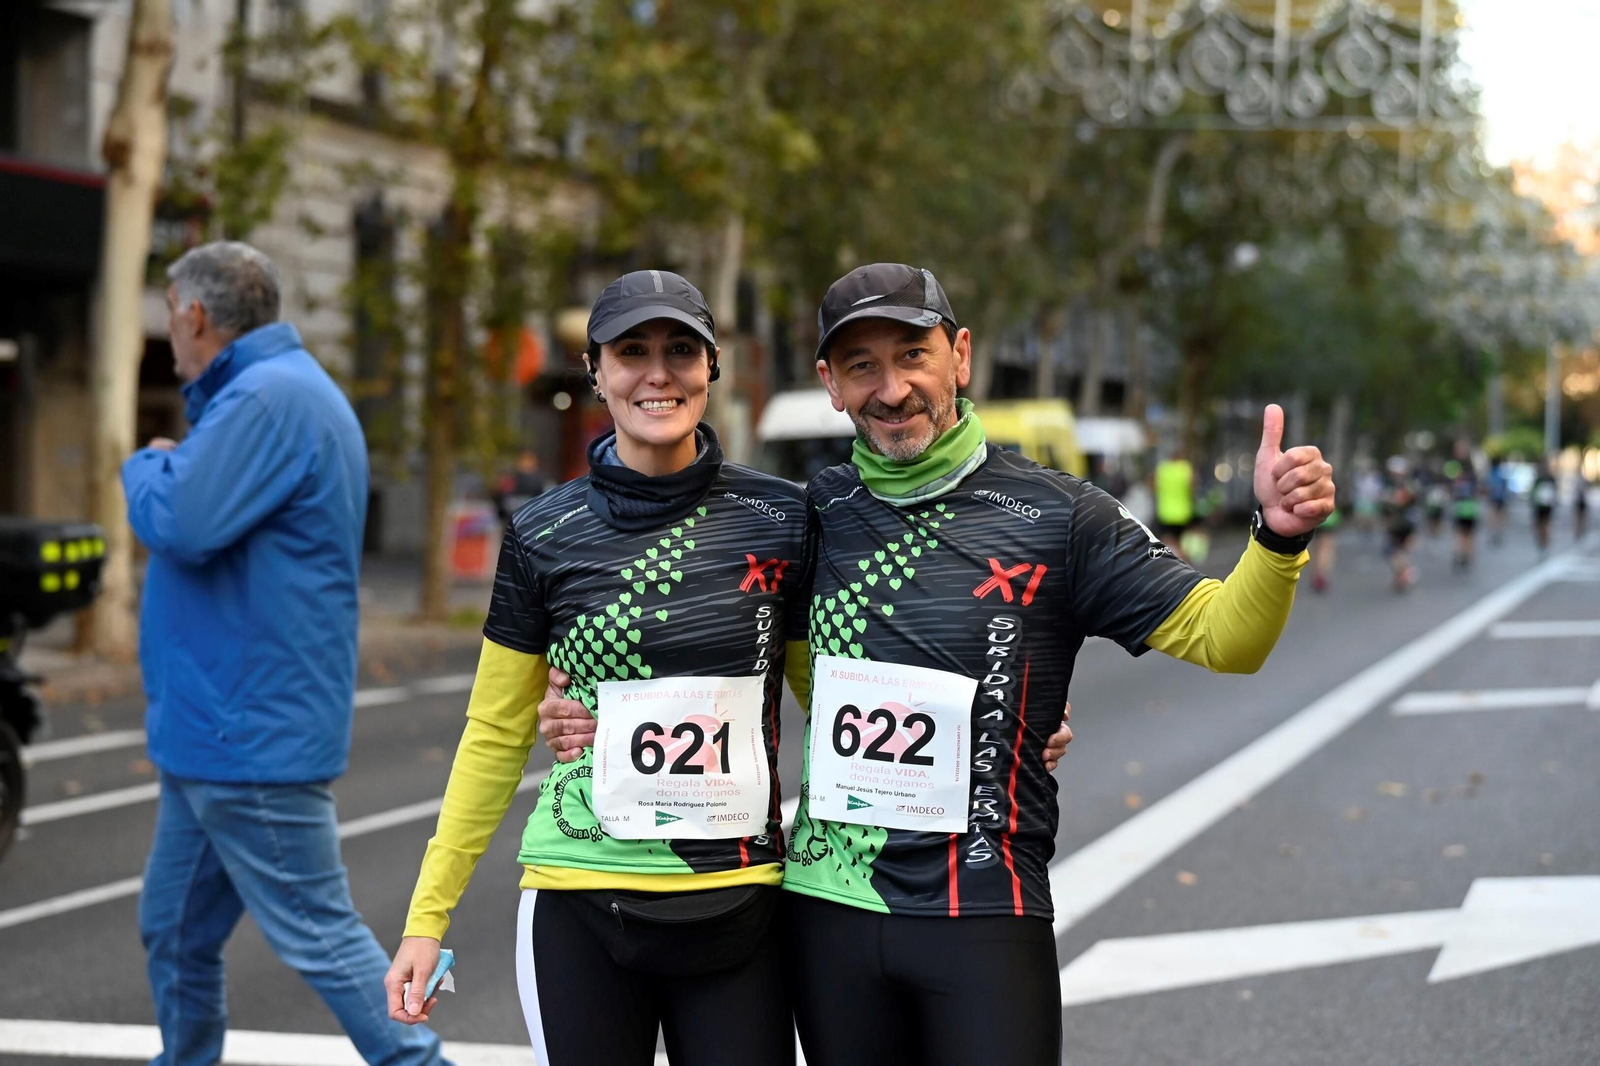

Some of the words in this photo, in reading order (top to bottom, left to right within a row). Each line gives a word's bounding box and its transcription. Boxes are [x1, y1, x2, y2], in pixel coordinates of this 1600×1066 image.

[738, 495, 786, 521] IMDECO
[988, 491, 1041, 519] IMDECO
[739, 553, 789, 595] XI
[972, 557, 1048, 607] XI
[752, 604, 773, 676] SUBID
[982, 617, 1016, 701] SUBIDA
[829, 669, 838, 679] XI
[838, 670, 870, 683] SUBIDA
[871, 675, 880, 684] A
[881, 677, 900, 687] LAS
[621, 693, 631, 702] XI
[633, 690, 671, 701] SUBIDA
[672, 690, 681, 699] A
[683, 690, 704, 699] LAS
[706, 689, 743, 699] ERMITAS
[630, 721, 731, 776] 621
[832, 704, 936, 767] 622
[972, 732, 1001, 772] LAS
[555, 767, 579, 801] AMIGOS
[656, 779, 701, 790] Regala
[704, 778, 737, 788] VIDA,
[850, 772, 880, 784] dona
[882, 776, 936, 790] órganos
[851, 762, 891, 775] Regala
[894, 768, 931, 780] VIDA,
[656, 788, 689, 798] dona
[692, 788, 742, 801] órganos
[836, 783, 856, 791] Manuel
[856, 786, 873, 794] Jesús
[875, 788, 893, 796] Tejero
[894, 790, 917, 799] Urbano
[718, 813, 749, 822] IMDECO
[906, 806, 944, 815] IMDECO
